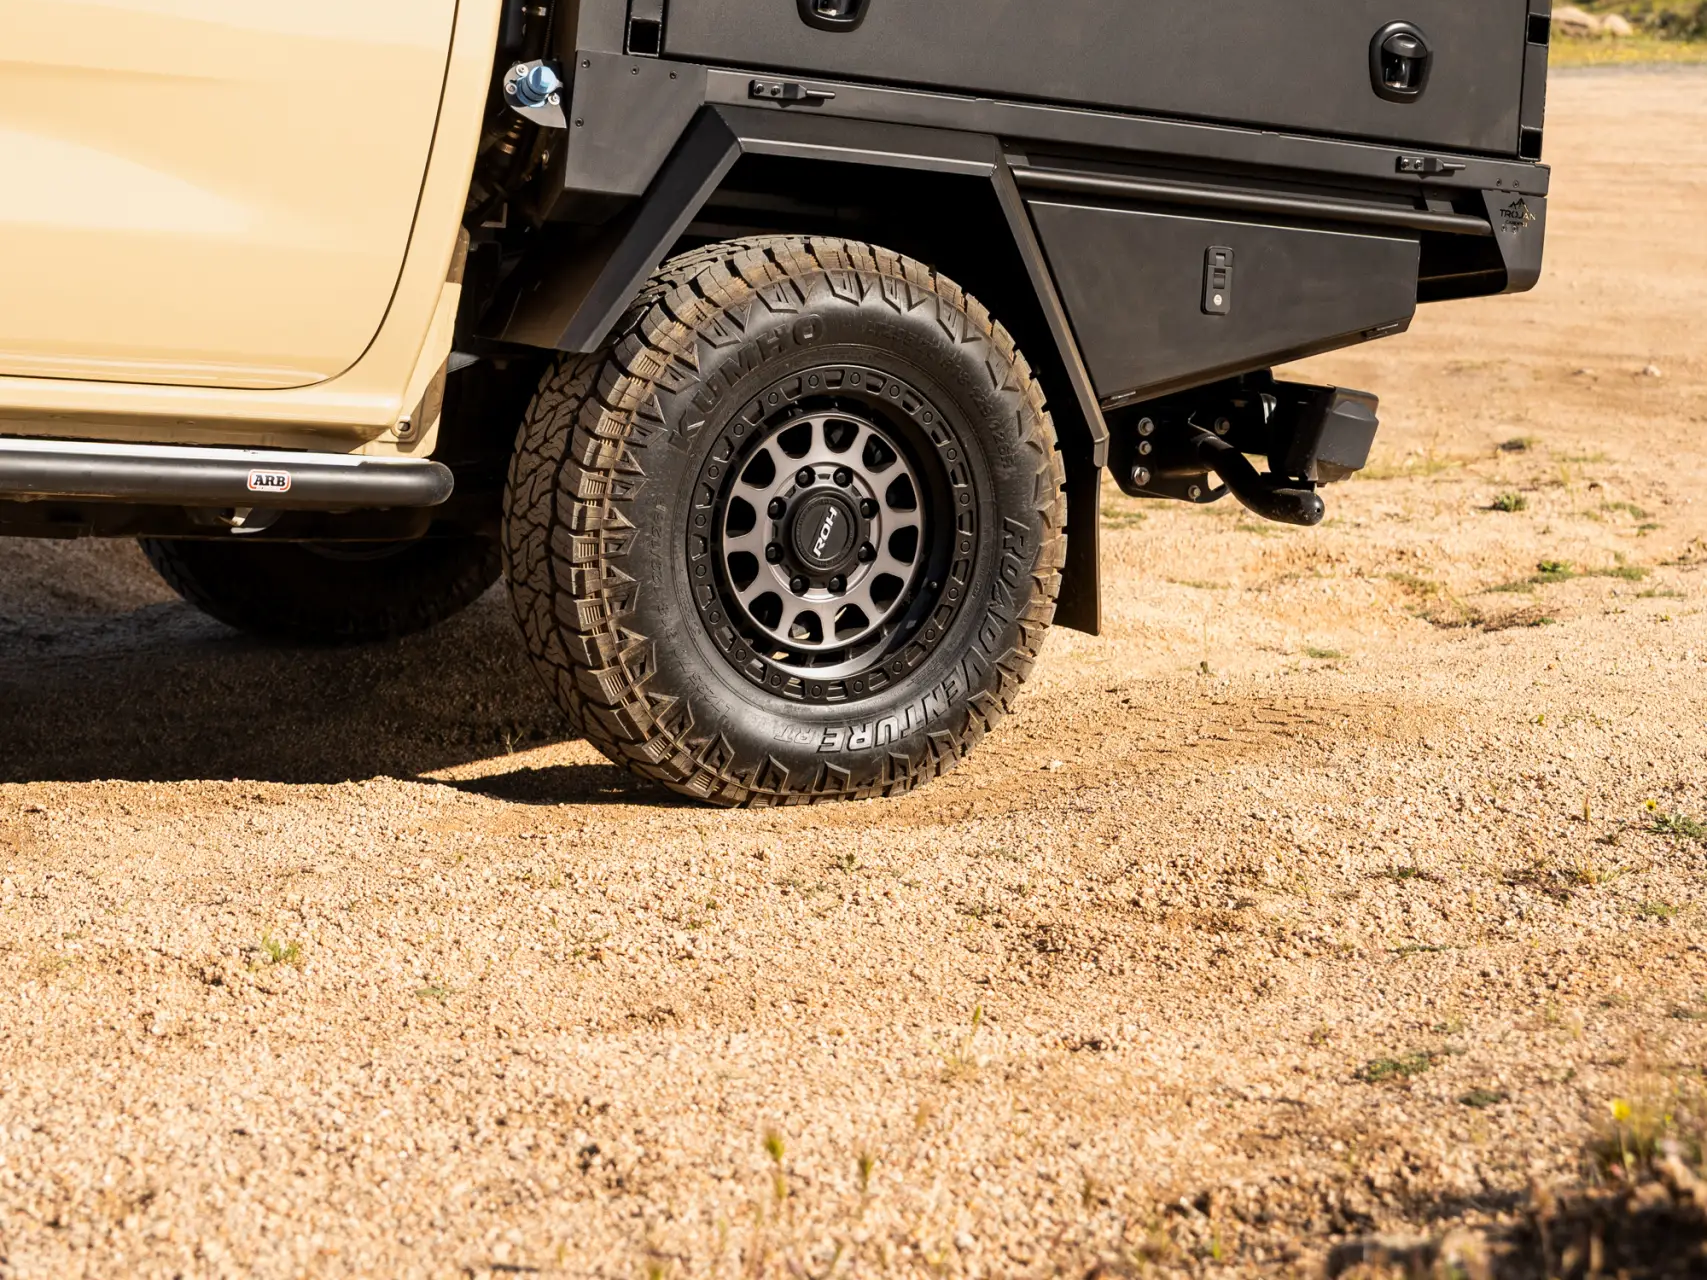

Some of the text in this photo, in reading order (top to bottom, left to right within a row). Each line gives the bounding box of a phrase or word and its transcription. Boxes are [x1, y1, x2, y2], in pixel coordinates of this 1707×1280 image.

[1499, 208, 1536, 221] TROJAN
[668, 313, 824, 454] KUMHO
[253, 474, 286, 487] ARB
[813, 506, 838, 558] ROH
[978, 516, 1031, 654] ROAD
[815, 644, 991, 754] VENTURE
